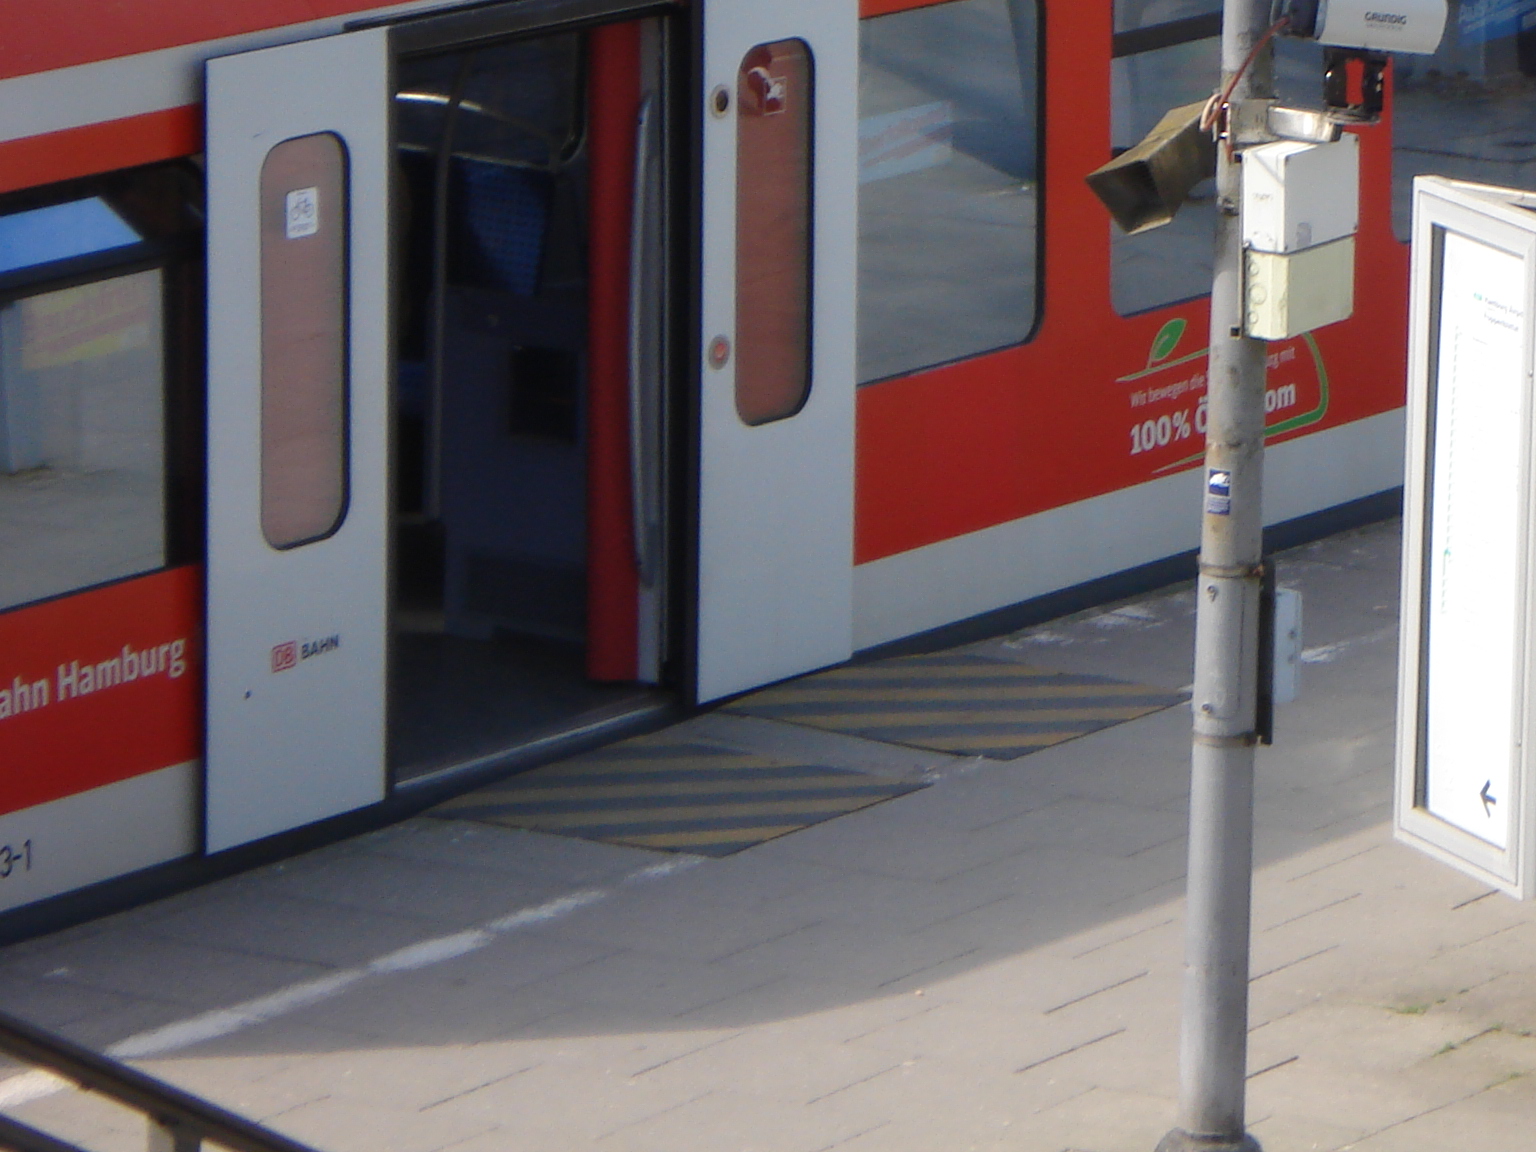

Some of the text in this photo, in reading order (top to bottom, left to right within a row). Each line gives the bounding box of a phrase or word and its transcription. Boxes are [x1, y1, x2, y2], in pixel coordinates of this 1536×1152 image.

[1364, 10, 1407, 26] GRUNDIG
[1148, 378, 1190, 401] bewegen
[1190, 374, 1204, 391] die
[1129, 408, 1191, 456] 100%
[56, 636, 187, 703] Hamburg
[273, 634, 340, 671] DB BAHN
